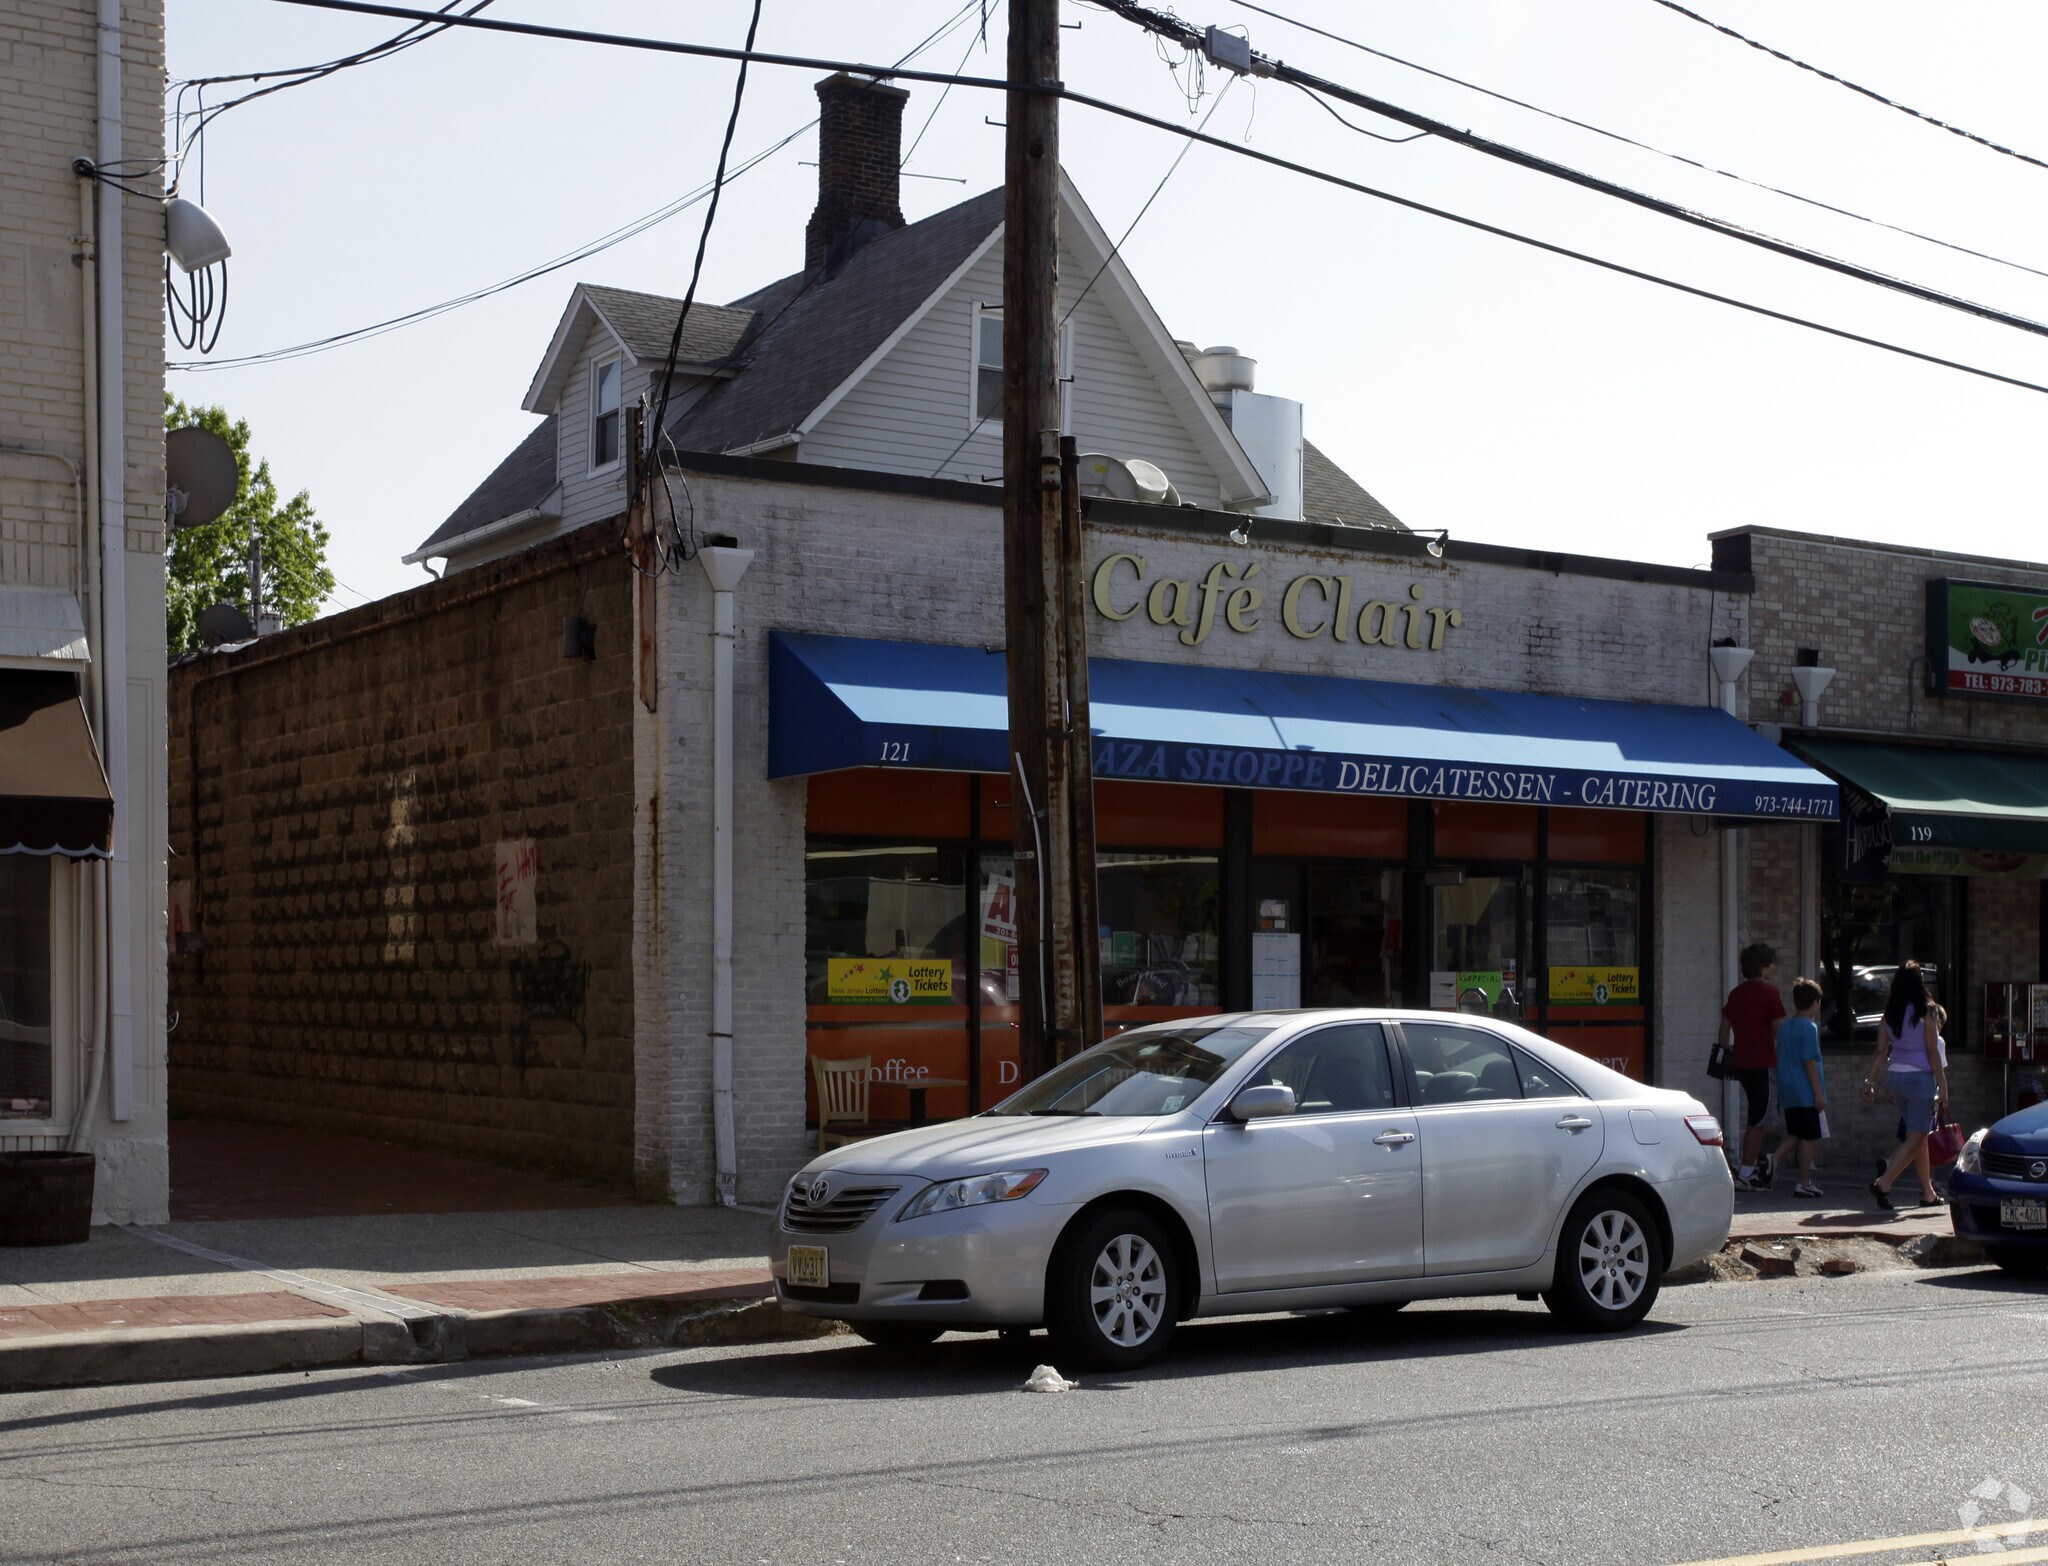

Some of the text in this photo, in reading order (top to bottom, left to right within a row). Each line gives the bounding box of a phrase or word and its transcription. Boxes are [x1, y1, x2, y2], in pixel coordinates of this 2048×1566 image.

[1093, 552, 1463, 651] Café Clair
[1964, 673, 2048, 696] TEL: 973-783-
[880, 741, 910, 762] 121
[1092, 741, 1168, 778] AZA
[1181, 747, 1327, 788] SHOPPE
[1336, 761, 1556, 801] DELICATESSEN
[1581, 777, 1717, 811] CATERING
[1755, 795, 1834, 815] 973-744-1771
[1910, 826, 1932, 841] 119
[908, 966, 945, 980] Lottery
[1146, 971, 1168, 989] Head
[1608, 973, 1634, 985] Lottery
[865, 987, 888, 996] Lottery
[914, 979, 948, 992] Tickets
[1611, 983, 1636, 995] Tickets
[851, 1058, 930, 1083] offee
